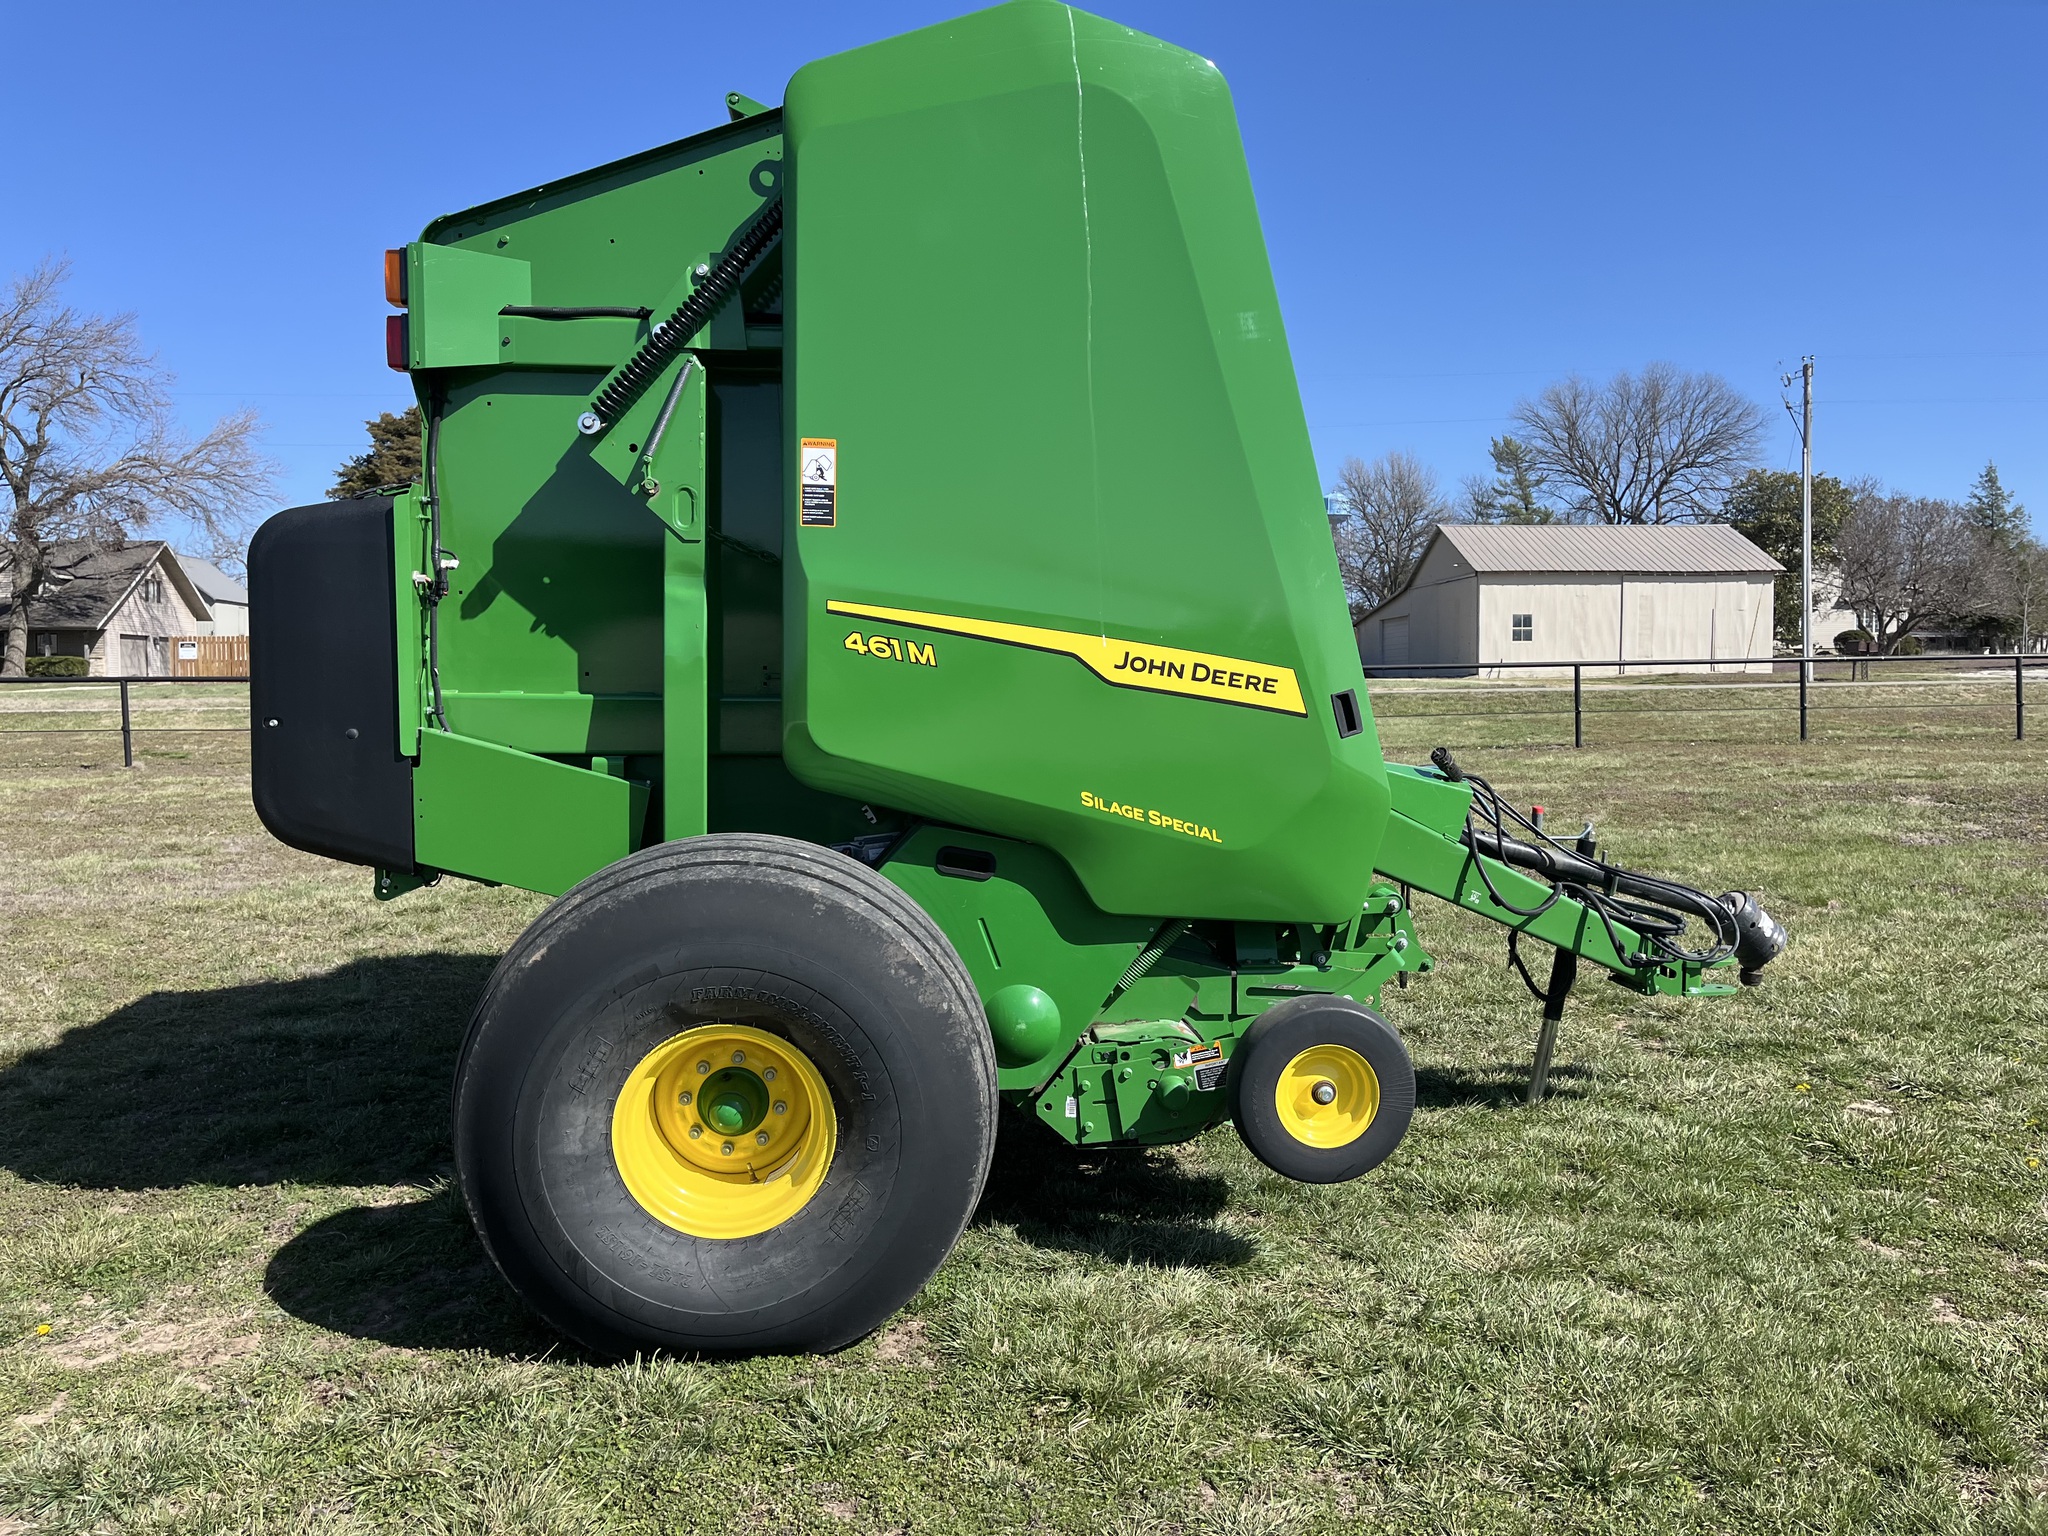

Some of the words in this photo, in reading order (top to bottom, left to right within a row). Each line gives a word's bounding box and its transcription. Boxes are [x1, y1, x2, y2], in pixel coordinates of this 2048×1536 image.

[1114, 651, 1185, 680] JOHN
[1190, 663, 1278, 694] DEERE
[1080, 791, 1145, 822] SILAGE
[1148, 809, 1223, 843] SPECIAL
[690, 985, 754, 1003] FARM
[755, 990, 863, 1067] IMPLEMENT
